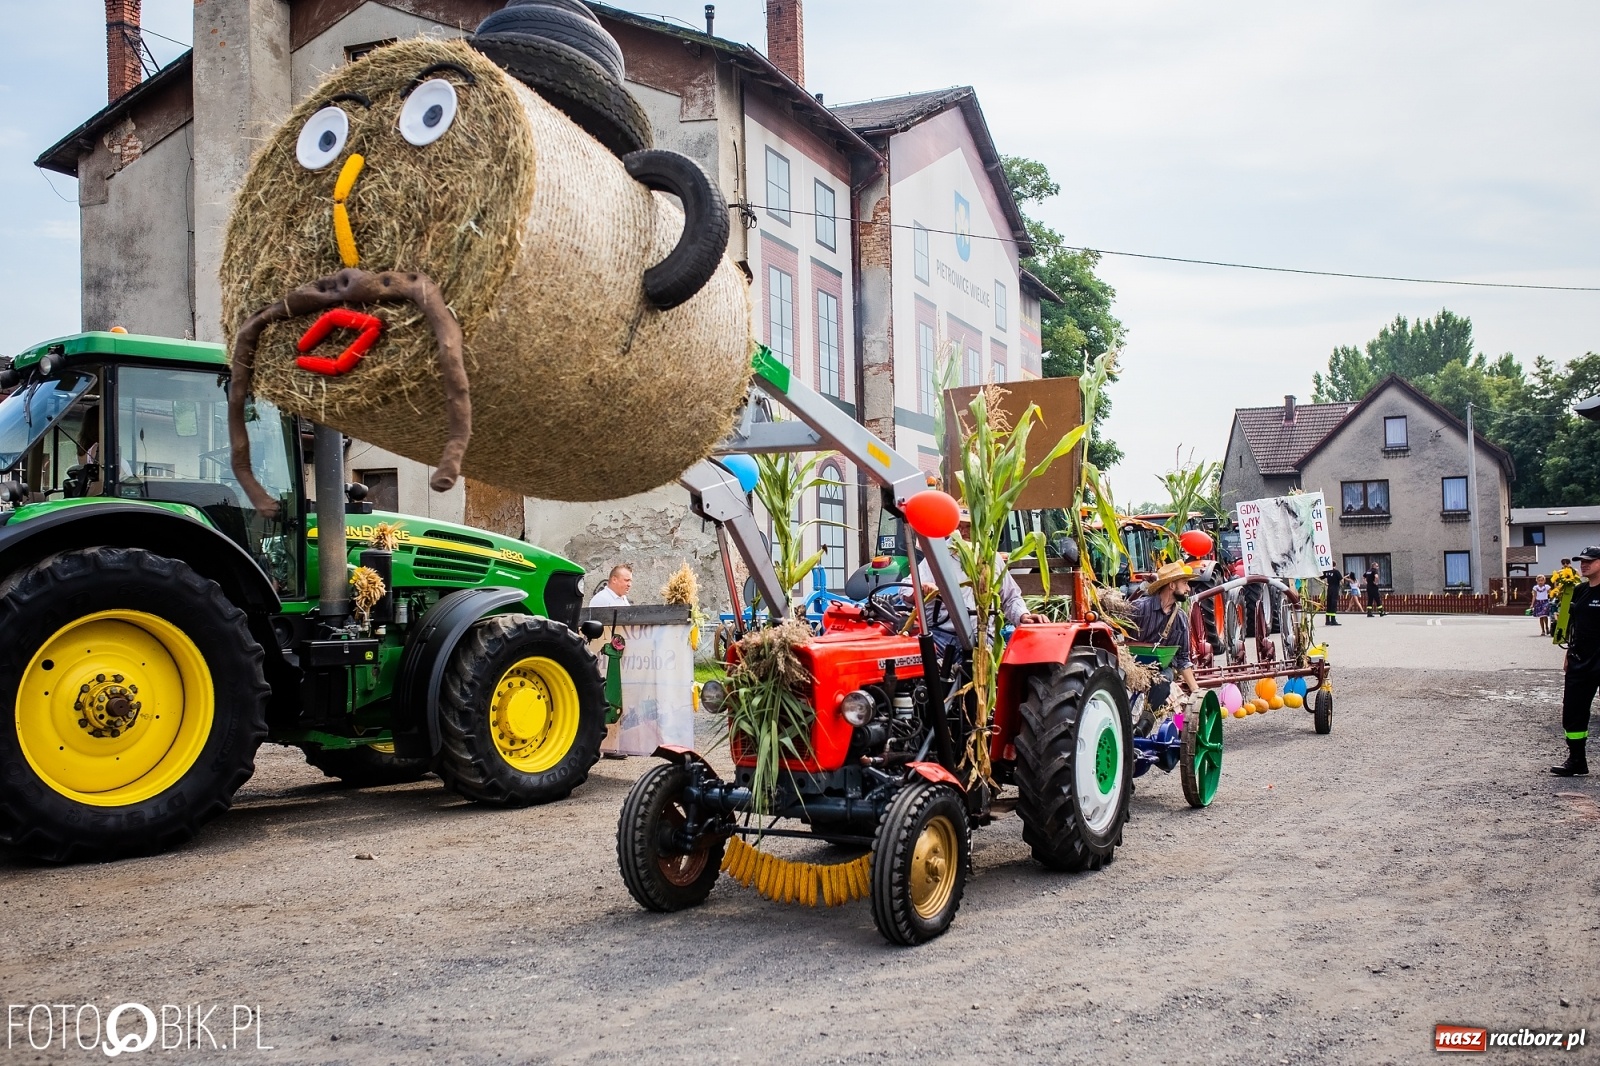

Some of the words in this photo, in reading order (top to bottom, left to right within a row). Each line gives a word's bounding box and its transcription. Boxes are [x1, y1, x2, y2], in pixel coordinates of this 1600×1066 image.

[936, 259, 969, 295] PIETROWICE
[970, 283, 990, 308] WIELKIE
[499, 547, 524, 563] 7820
[1315, 544, 1326, 555] TO
